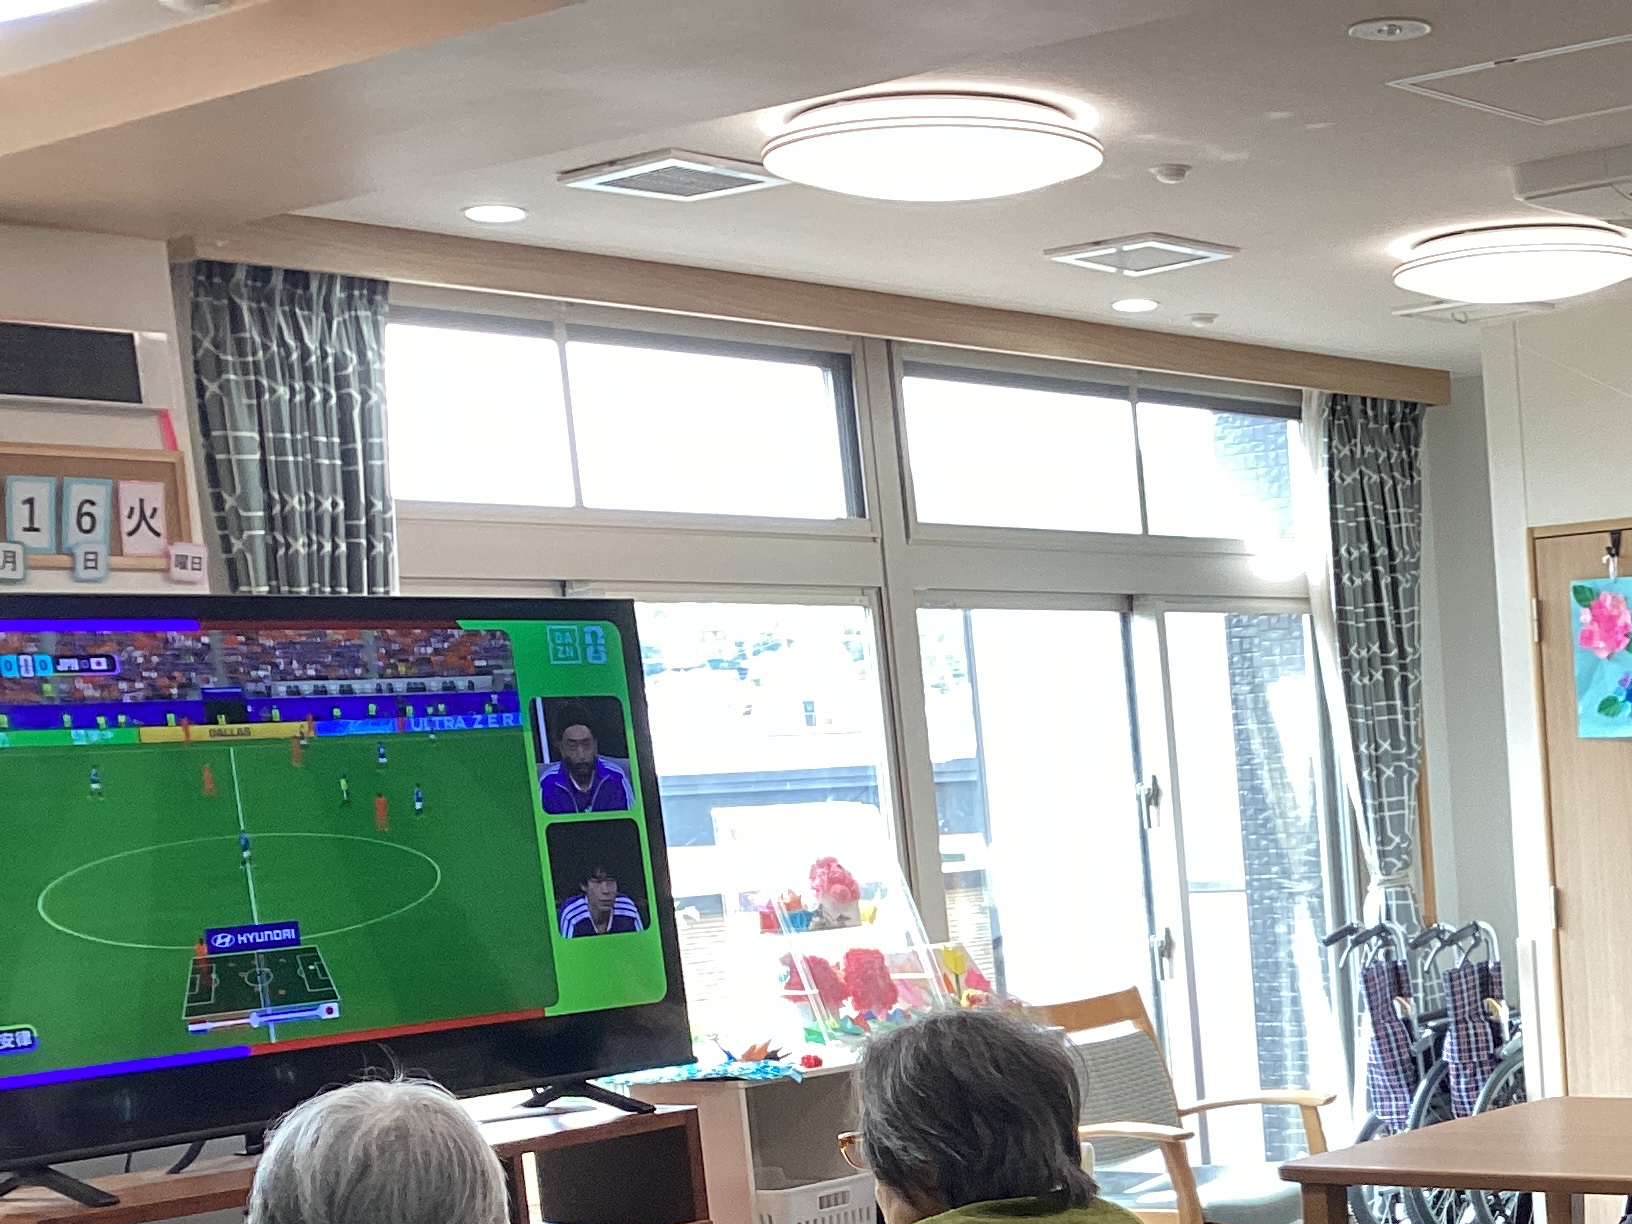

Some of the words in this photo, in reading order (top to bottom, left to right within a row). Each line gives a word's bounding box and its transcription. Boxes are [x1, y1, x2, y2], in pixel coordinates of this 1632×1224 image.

[125, 497, 162, 538] 火
[0, 550, 17, 572] 月
[82, 551, 99, 571] 日
[411, 714, 467, 732] ULTRA
[237, 928, 296, 945] HYUNDAI
